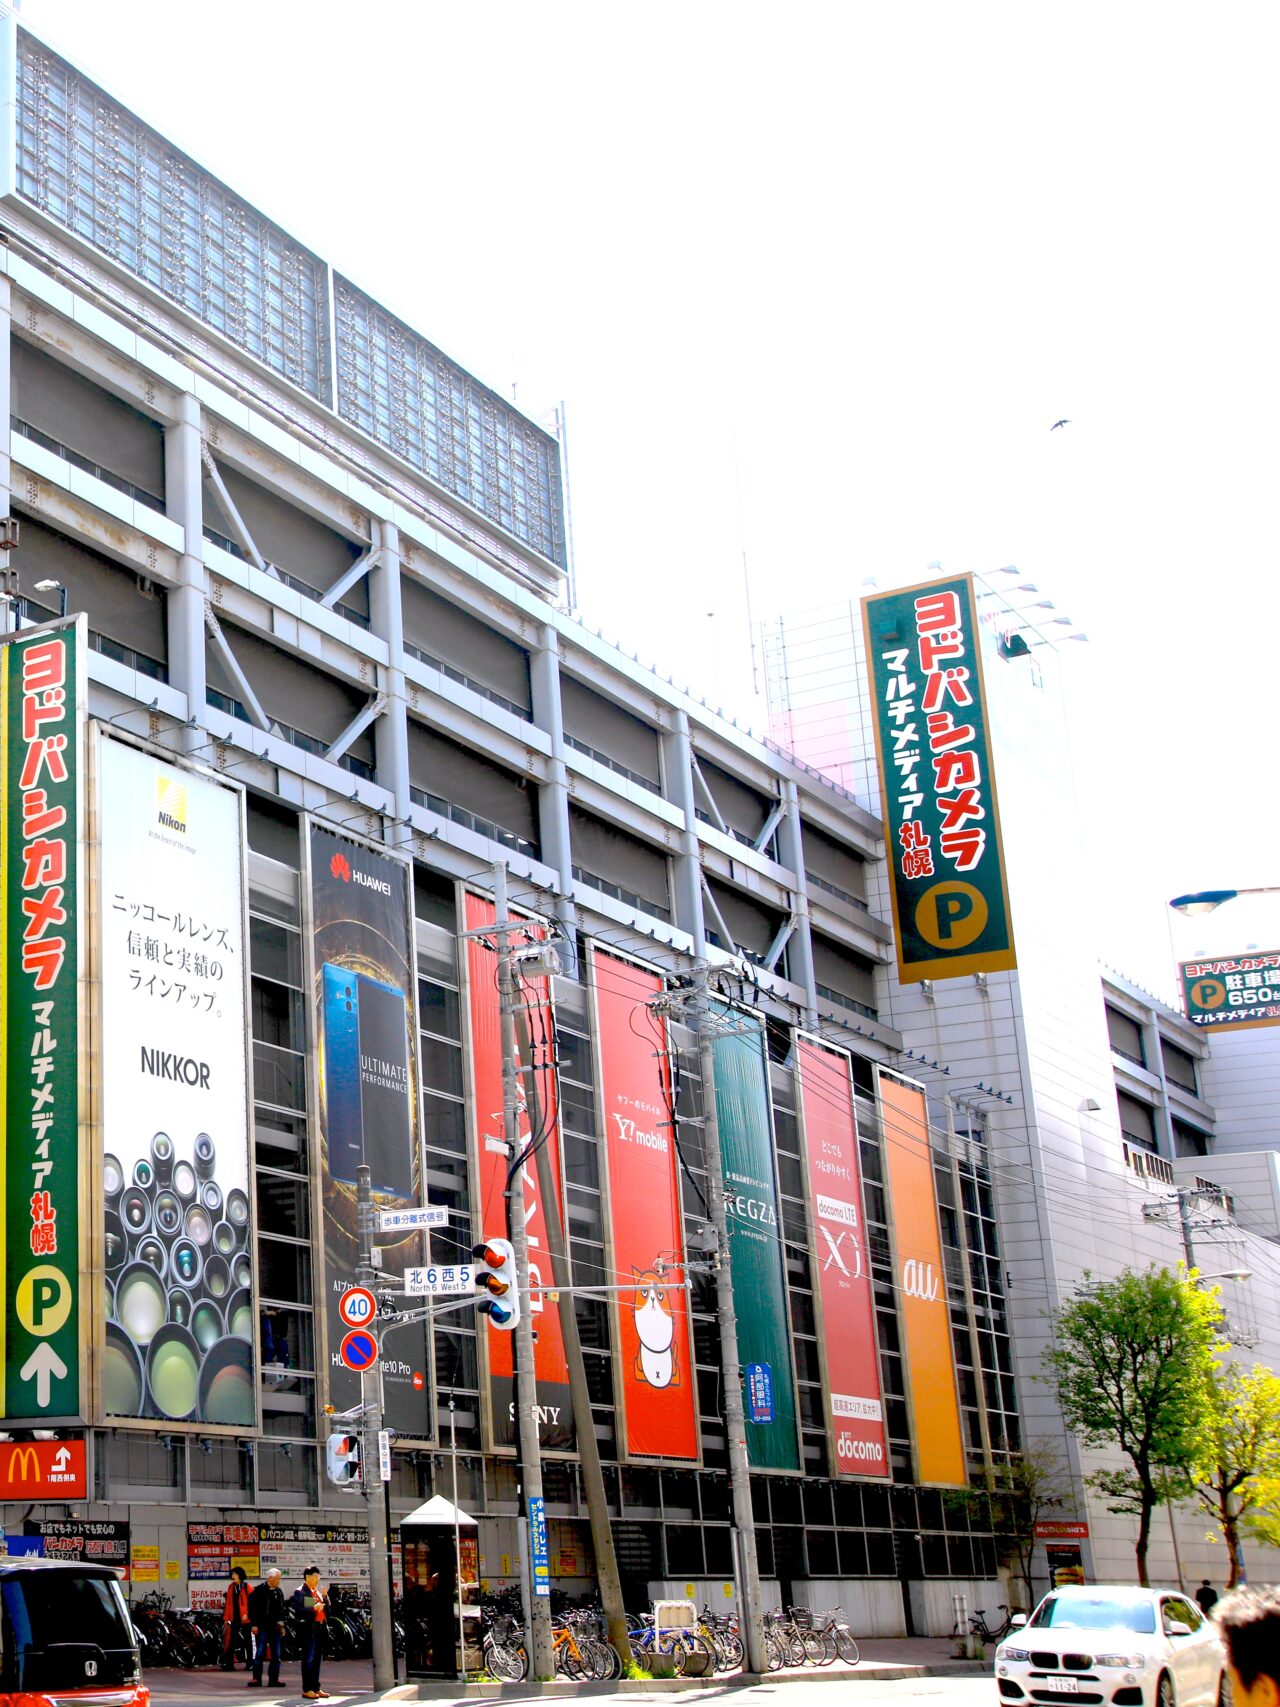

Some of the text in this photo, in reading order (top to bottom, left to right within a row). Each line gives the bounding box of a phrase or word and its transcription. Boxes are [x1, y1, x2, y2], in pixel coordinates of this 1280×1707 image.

[914, 591, 986, 872] ヨドバシカメラ
[881, 647, 935, 880] マルチメディア札幌
[158, 811, 186, 833] Nikon
[353, 869, 391, 897] HUAWEI
[935, 893, 974, 939] P
[20, 638, 69, 1256] ヨドバシカメラ マルチメディア札幌
[127, 930, 223, 981] 信頼と実績の
[1185, 955, 1280, 977] ヨドバシカメラ
[1225, 970, 1280, 991] 駐車場
[1201, 985, 1217, 1005] P
[1192, 1006, 1280, 1023] マルチメディア札
[141, 1046, 210, 1090] NIKKOR
[361, 1054, 408, 1083] ULTIMATE
[362, 1071, 408, 1094] PERFORMANCE
[384, 1211, 444, 1226] 歩車分離式信号
[819, 1201, 856, 1223] docomo LTE
[410, 1284, 431, 1293] North
[441, 1283, 460, 1292] West
[903, 1259, 940, 1301] au
[33, 1278, 61, 1326] P
[348, 1299, 368, 1317] 40
[399, 1361, 411, 1375] Pro
[509, 1402, 561, 1426] SNY
[837, 1431, 882, 1461] docomo
